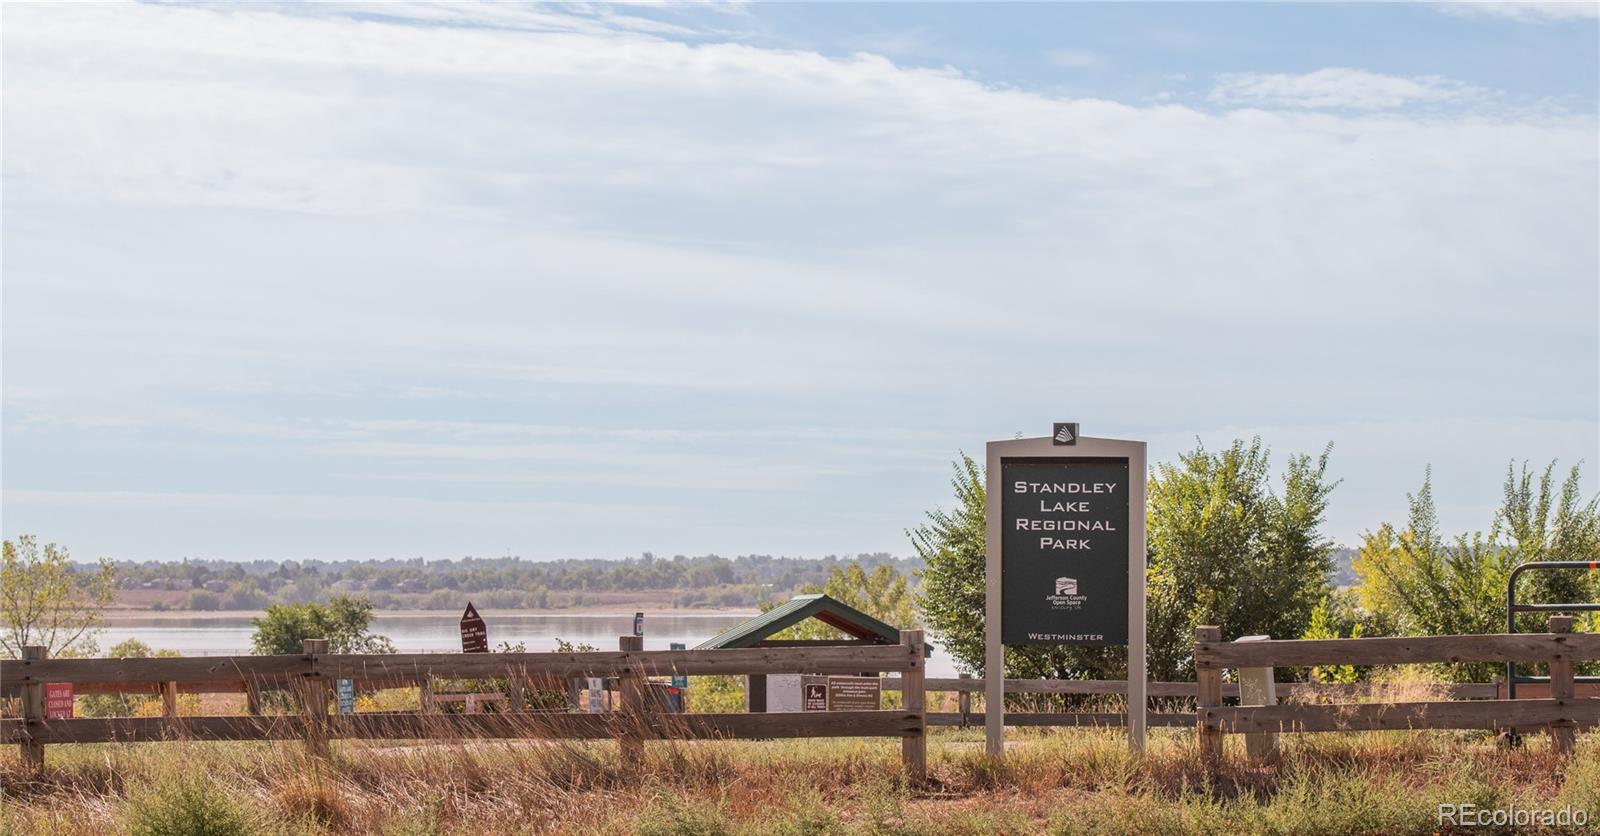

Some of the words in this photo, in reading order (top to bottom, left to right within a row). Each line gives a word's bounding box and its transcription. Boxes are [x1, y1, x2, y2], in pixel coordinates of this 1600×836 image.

[1014, 481, 1117, 494] STANDLEY
[1040, 500, 1090, 512] LAKE
[1016, 518, 1116, 531] REGIONAL
[1040, 537, 1091, 550] PARK
[1028, 632, 1104, 641] WESTMINSTER
